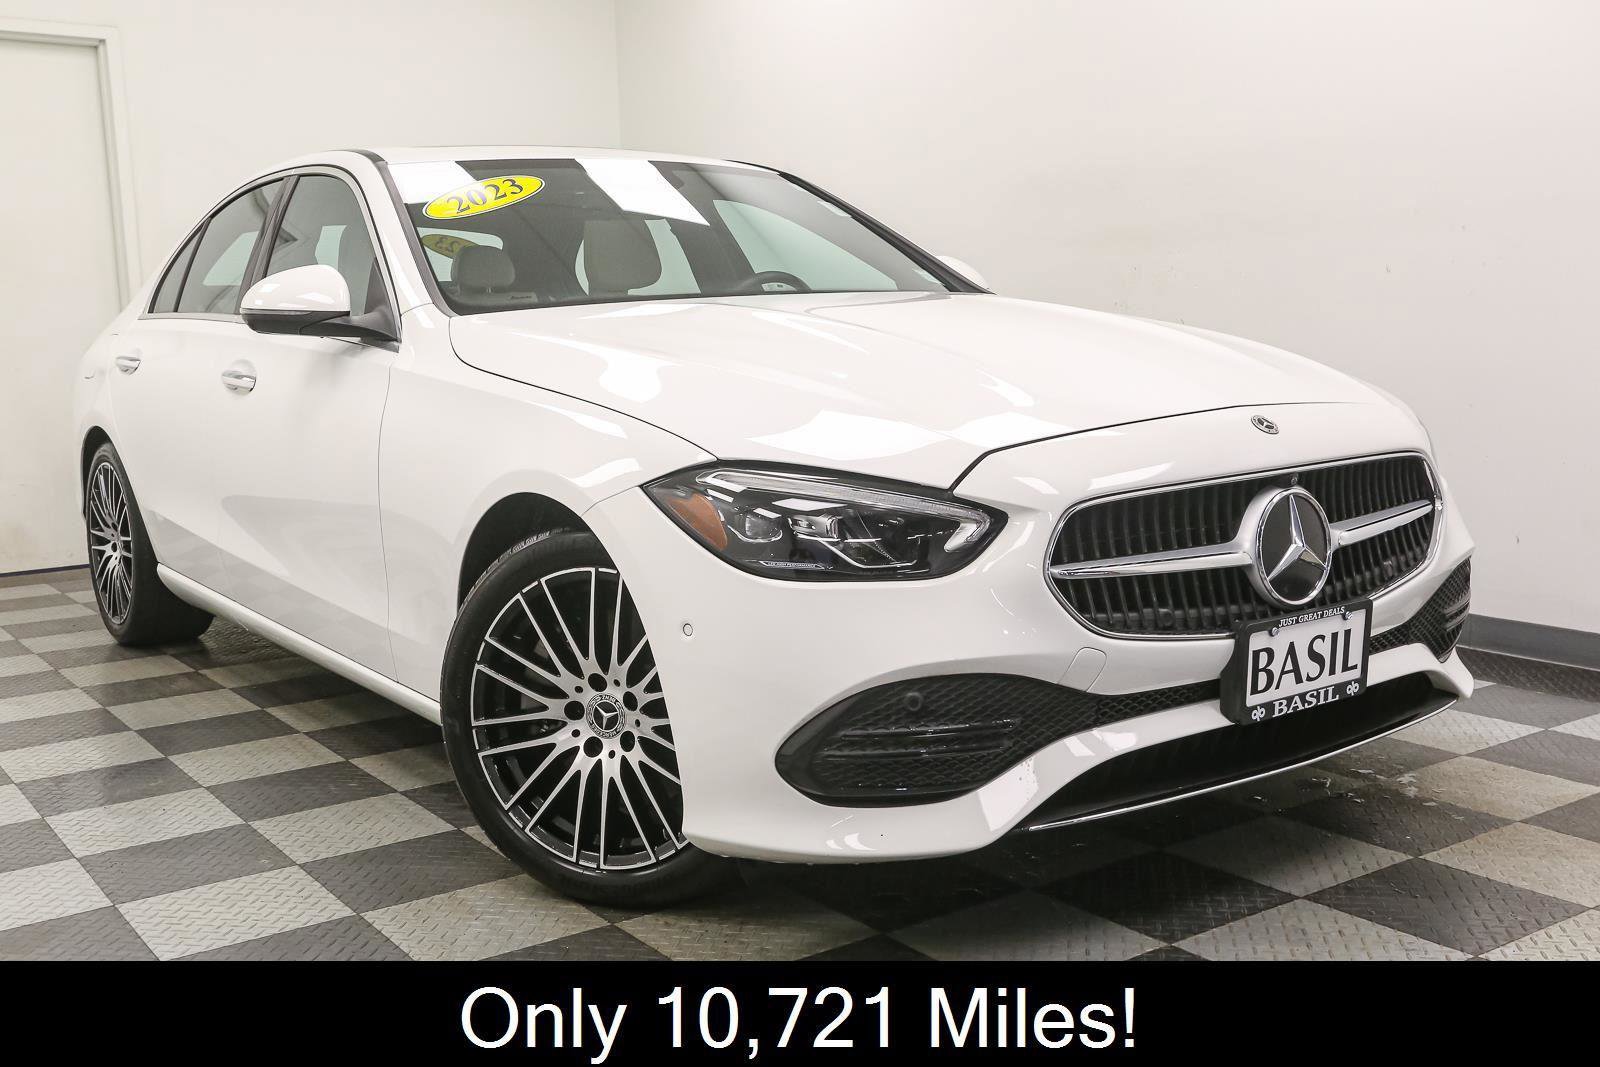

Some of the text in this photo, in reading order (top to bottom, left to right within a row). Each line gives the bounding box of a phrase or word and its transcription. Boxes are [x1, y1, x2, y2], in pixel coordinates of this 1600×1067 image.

[447, 178, 524, 214] 2023
[1279, 606, 1345, 627] JUST GREAT DEALS
[1250, 628, 1358, 696] BASIL
[1272, 686, 1339, 718] BASIL
